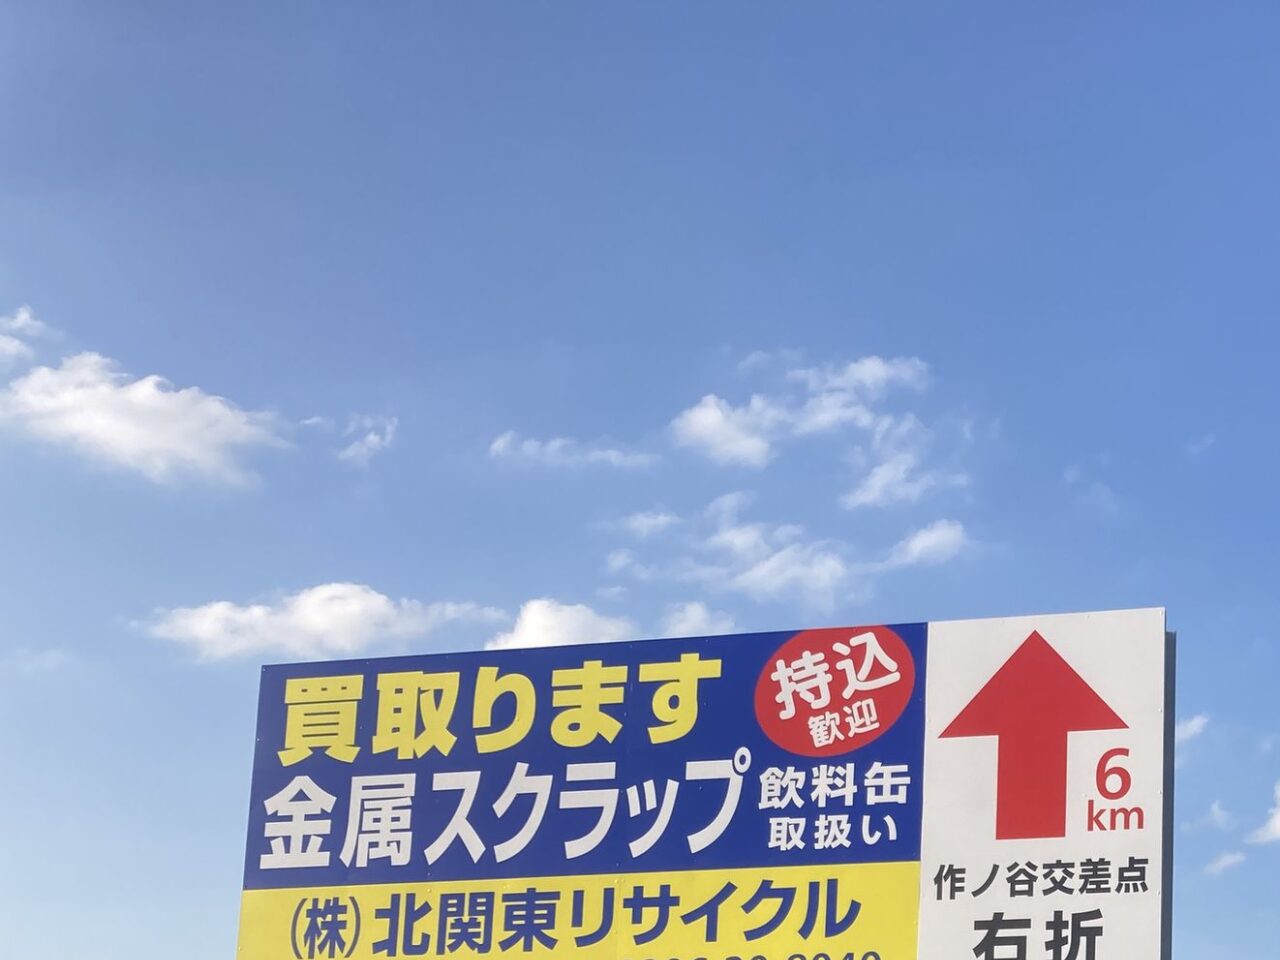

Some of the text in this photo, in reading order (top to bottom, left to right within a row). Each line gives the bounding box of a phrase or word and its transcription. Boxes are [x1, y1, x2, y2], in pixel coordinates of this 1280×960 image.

[771, 632, 901, 720] 持込
[277, 653, 722, 767] 買取ります
[807, 698, 880, 748] 歓迎
[758, 762, 911, 810] 飲料缶
[1095, 747, 1132, 801] 6
[259, 747, 752, 871] 金属スクラップ
[768, 814, 897, 851] 取扱い
[1087, 800, 1144, 832] km
[933, 857, 1149, 900] 作ノ谷交差点
